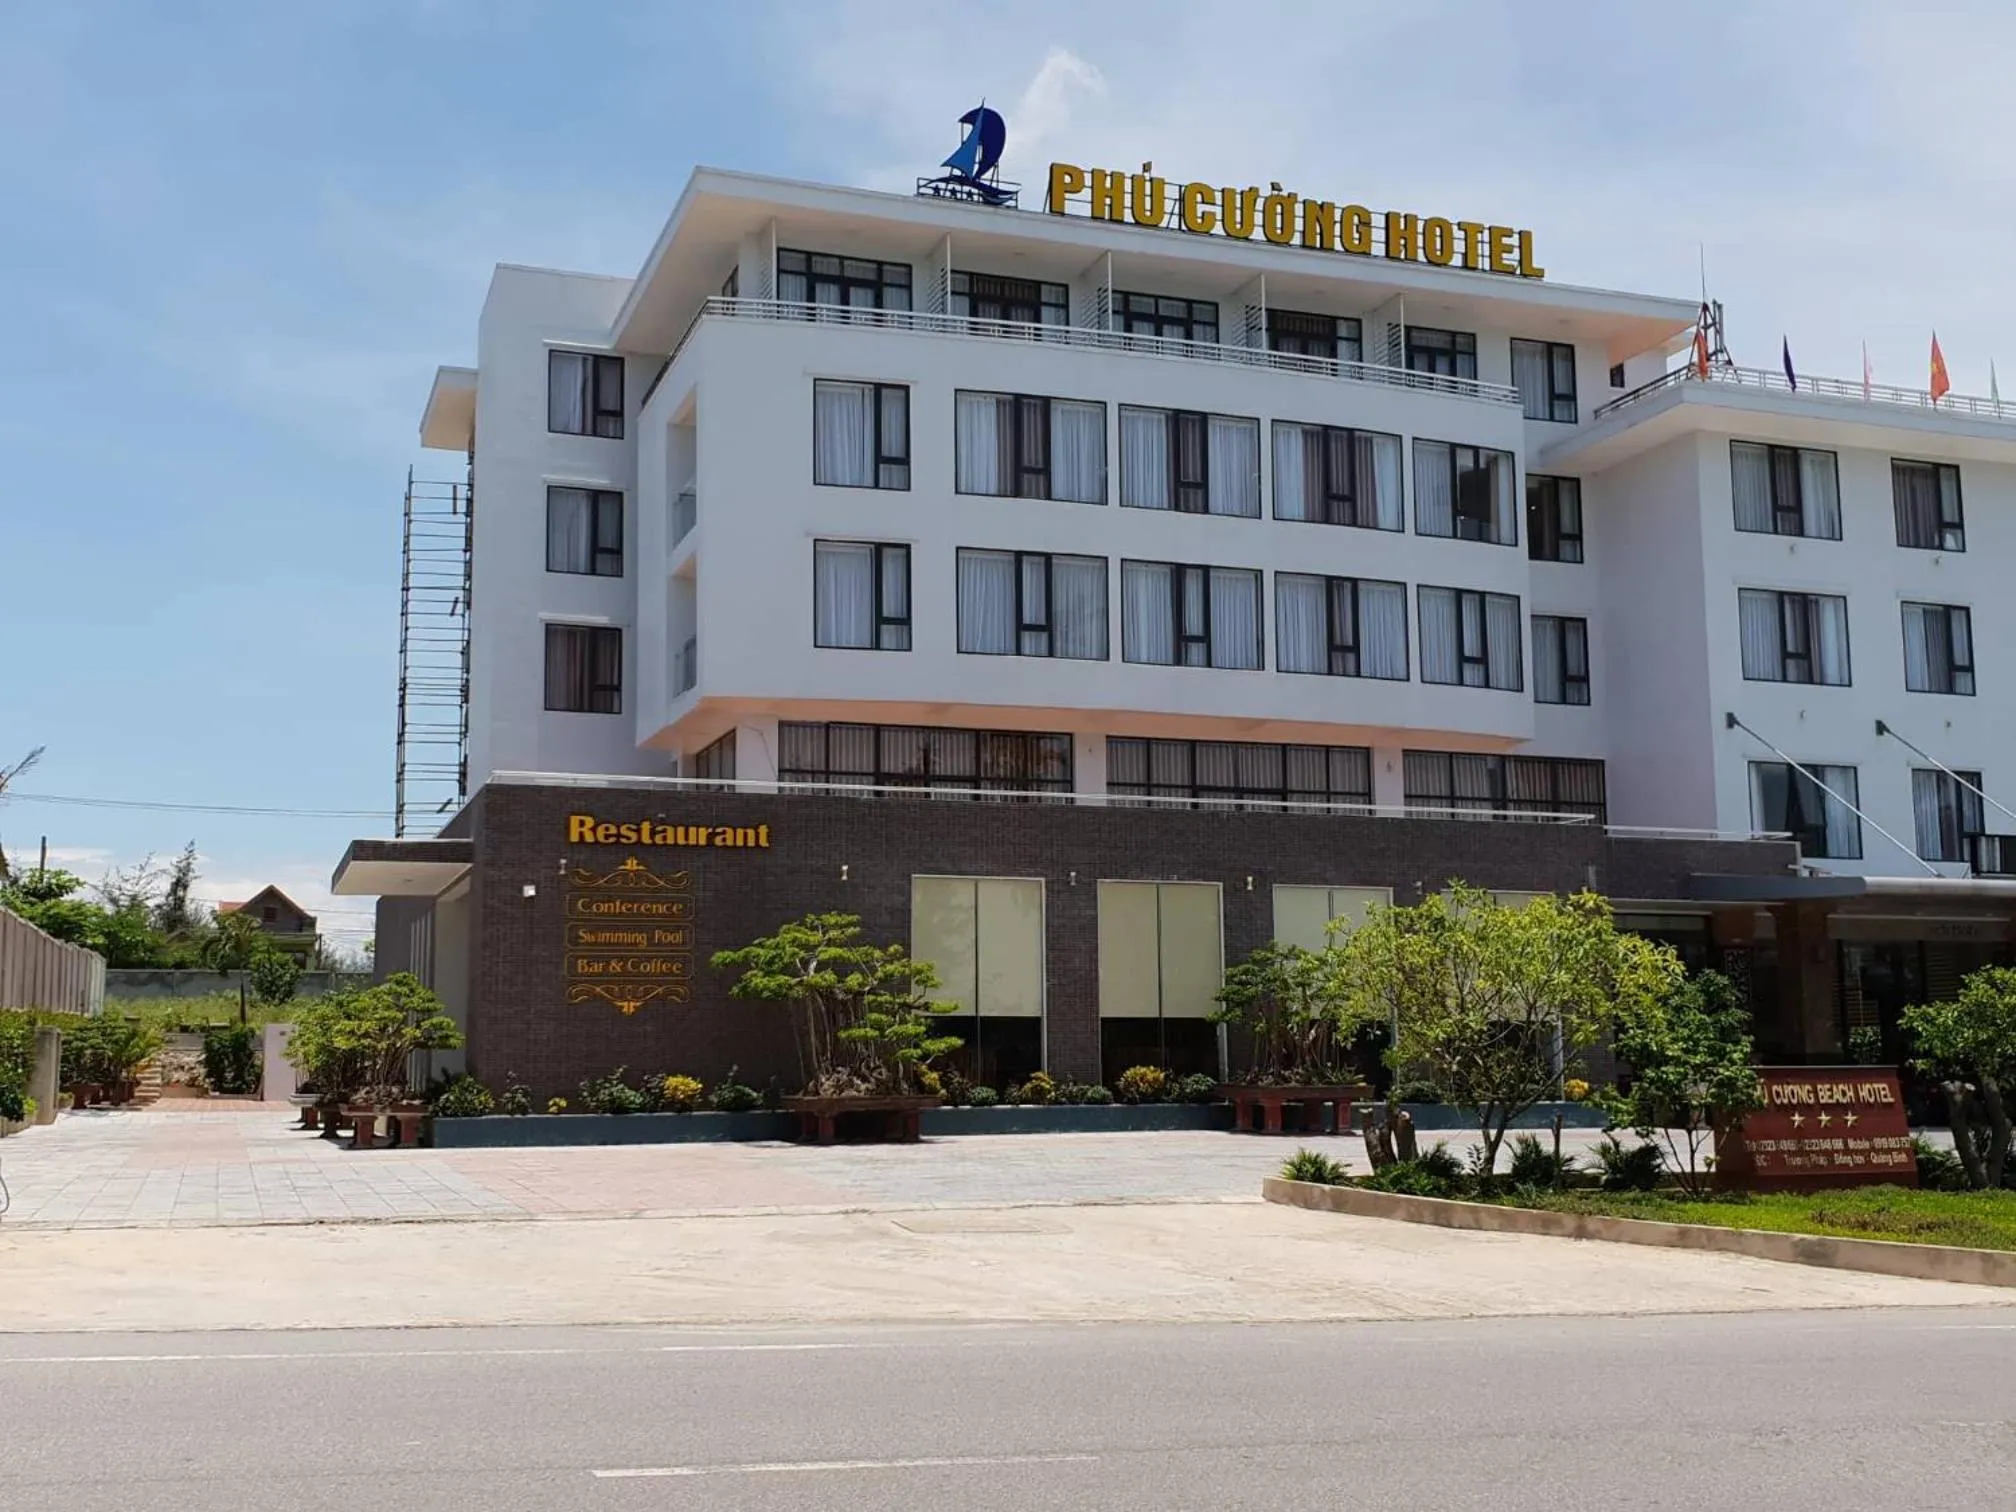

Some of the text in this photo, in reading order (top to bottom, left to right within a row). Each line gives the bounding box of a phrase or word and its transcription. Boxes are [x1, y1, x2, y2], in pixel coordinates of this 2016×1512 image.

[1050, 161, 1545, 278] PHÚ CƯỜNG HOTEL
[569, 815, 770, 848] Restaurant
[577, 898, 684, 915] Conference
[578, 929, 684, 949] Swimming Pool
[577, 958, 683, 974] Bar & Coffee
[1816, 1083, 1856, 1104] BEACH
[1858, 1083, 1896, 1103] HOTEL
